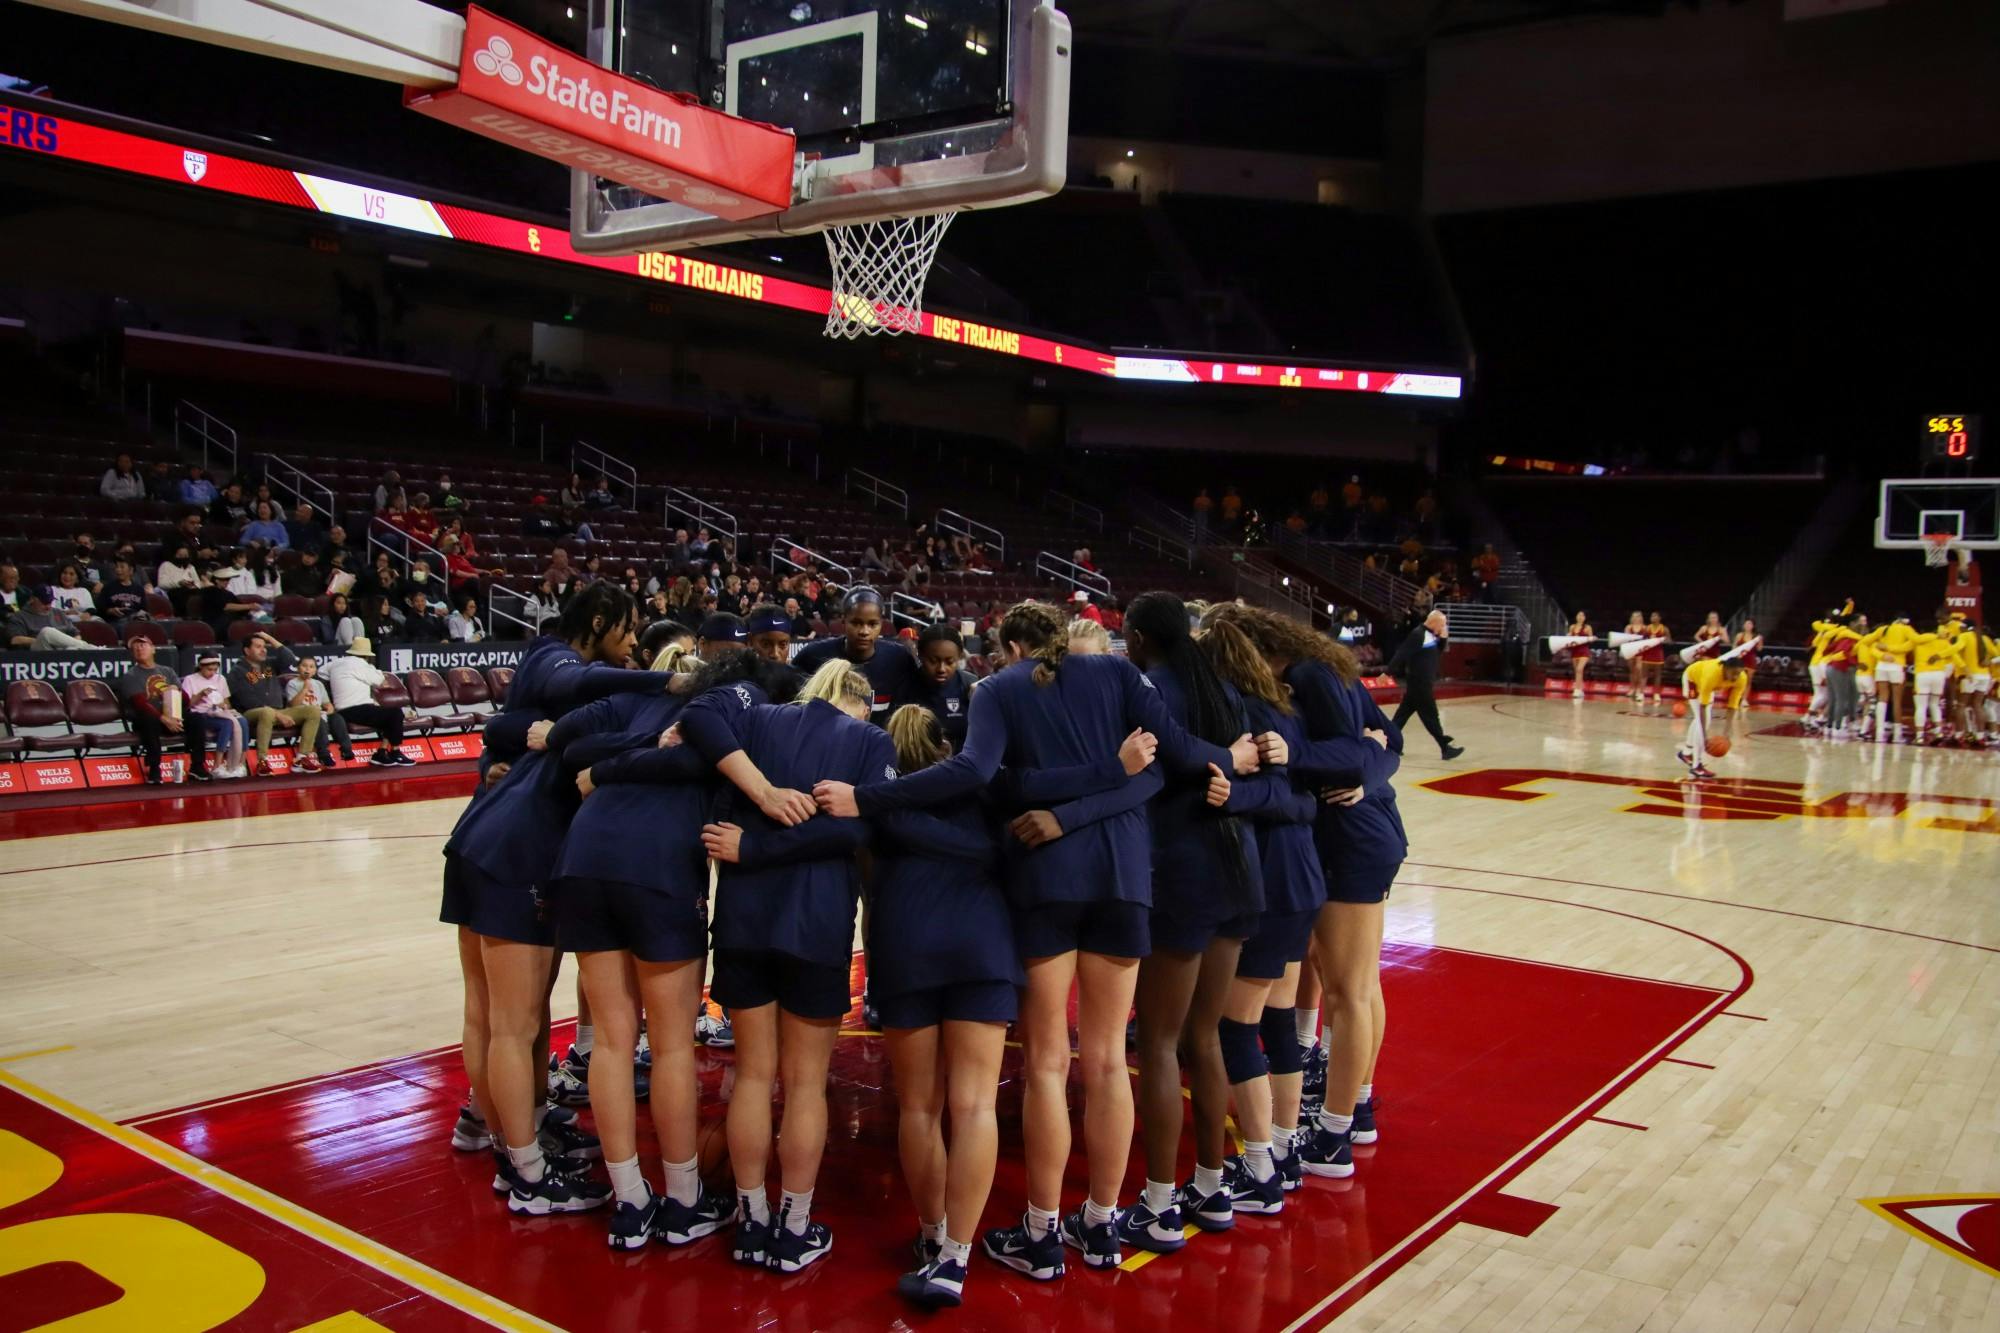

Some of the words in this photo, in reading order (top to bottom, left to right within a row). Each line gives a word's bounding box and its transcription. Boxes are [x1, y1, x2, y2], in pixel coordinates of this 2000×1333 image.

[363, 193, 385, 220] VS
[638, 251, 677, 283] USC
[680, 257, 763, 300] TROJANS
[933, 314, 960, 342] USC
[963, 322, 1020, 354] TROJANS
[1928, 418, 1964, 433] 56.5
[1948, 432, 1967, 456] 0
[1945, 597, 1977, 607] YETI
[1, 661, 132, 681] TRUSTCAPIT
[440, 740, 464, 749] WELLS
[404, 751, 424, 760] ARGO
[444, 747, 467, 756] FARGO
[265, 754, 286, 762] ELLS
[37, 767, 71, 777] WELLS
[97, 764, 129, 773] WELLS
[40, 775, 73, 785] FARGO
[99, 771, 132, 781] FARGO
